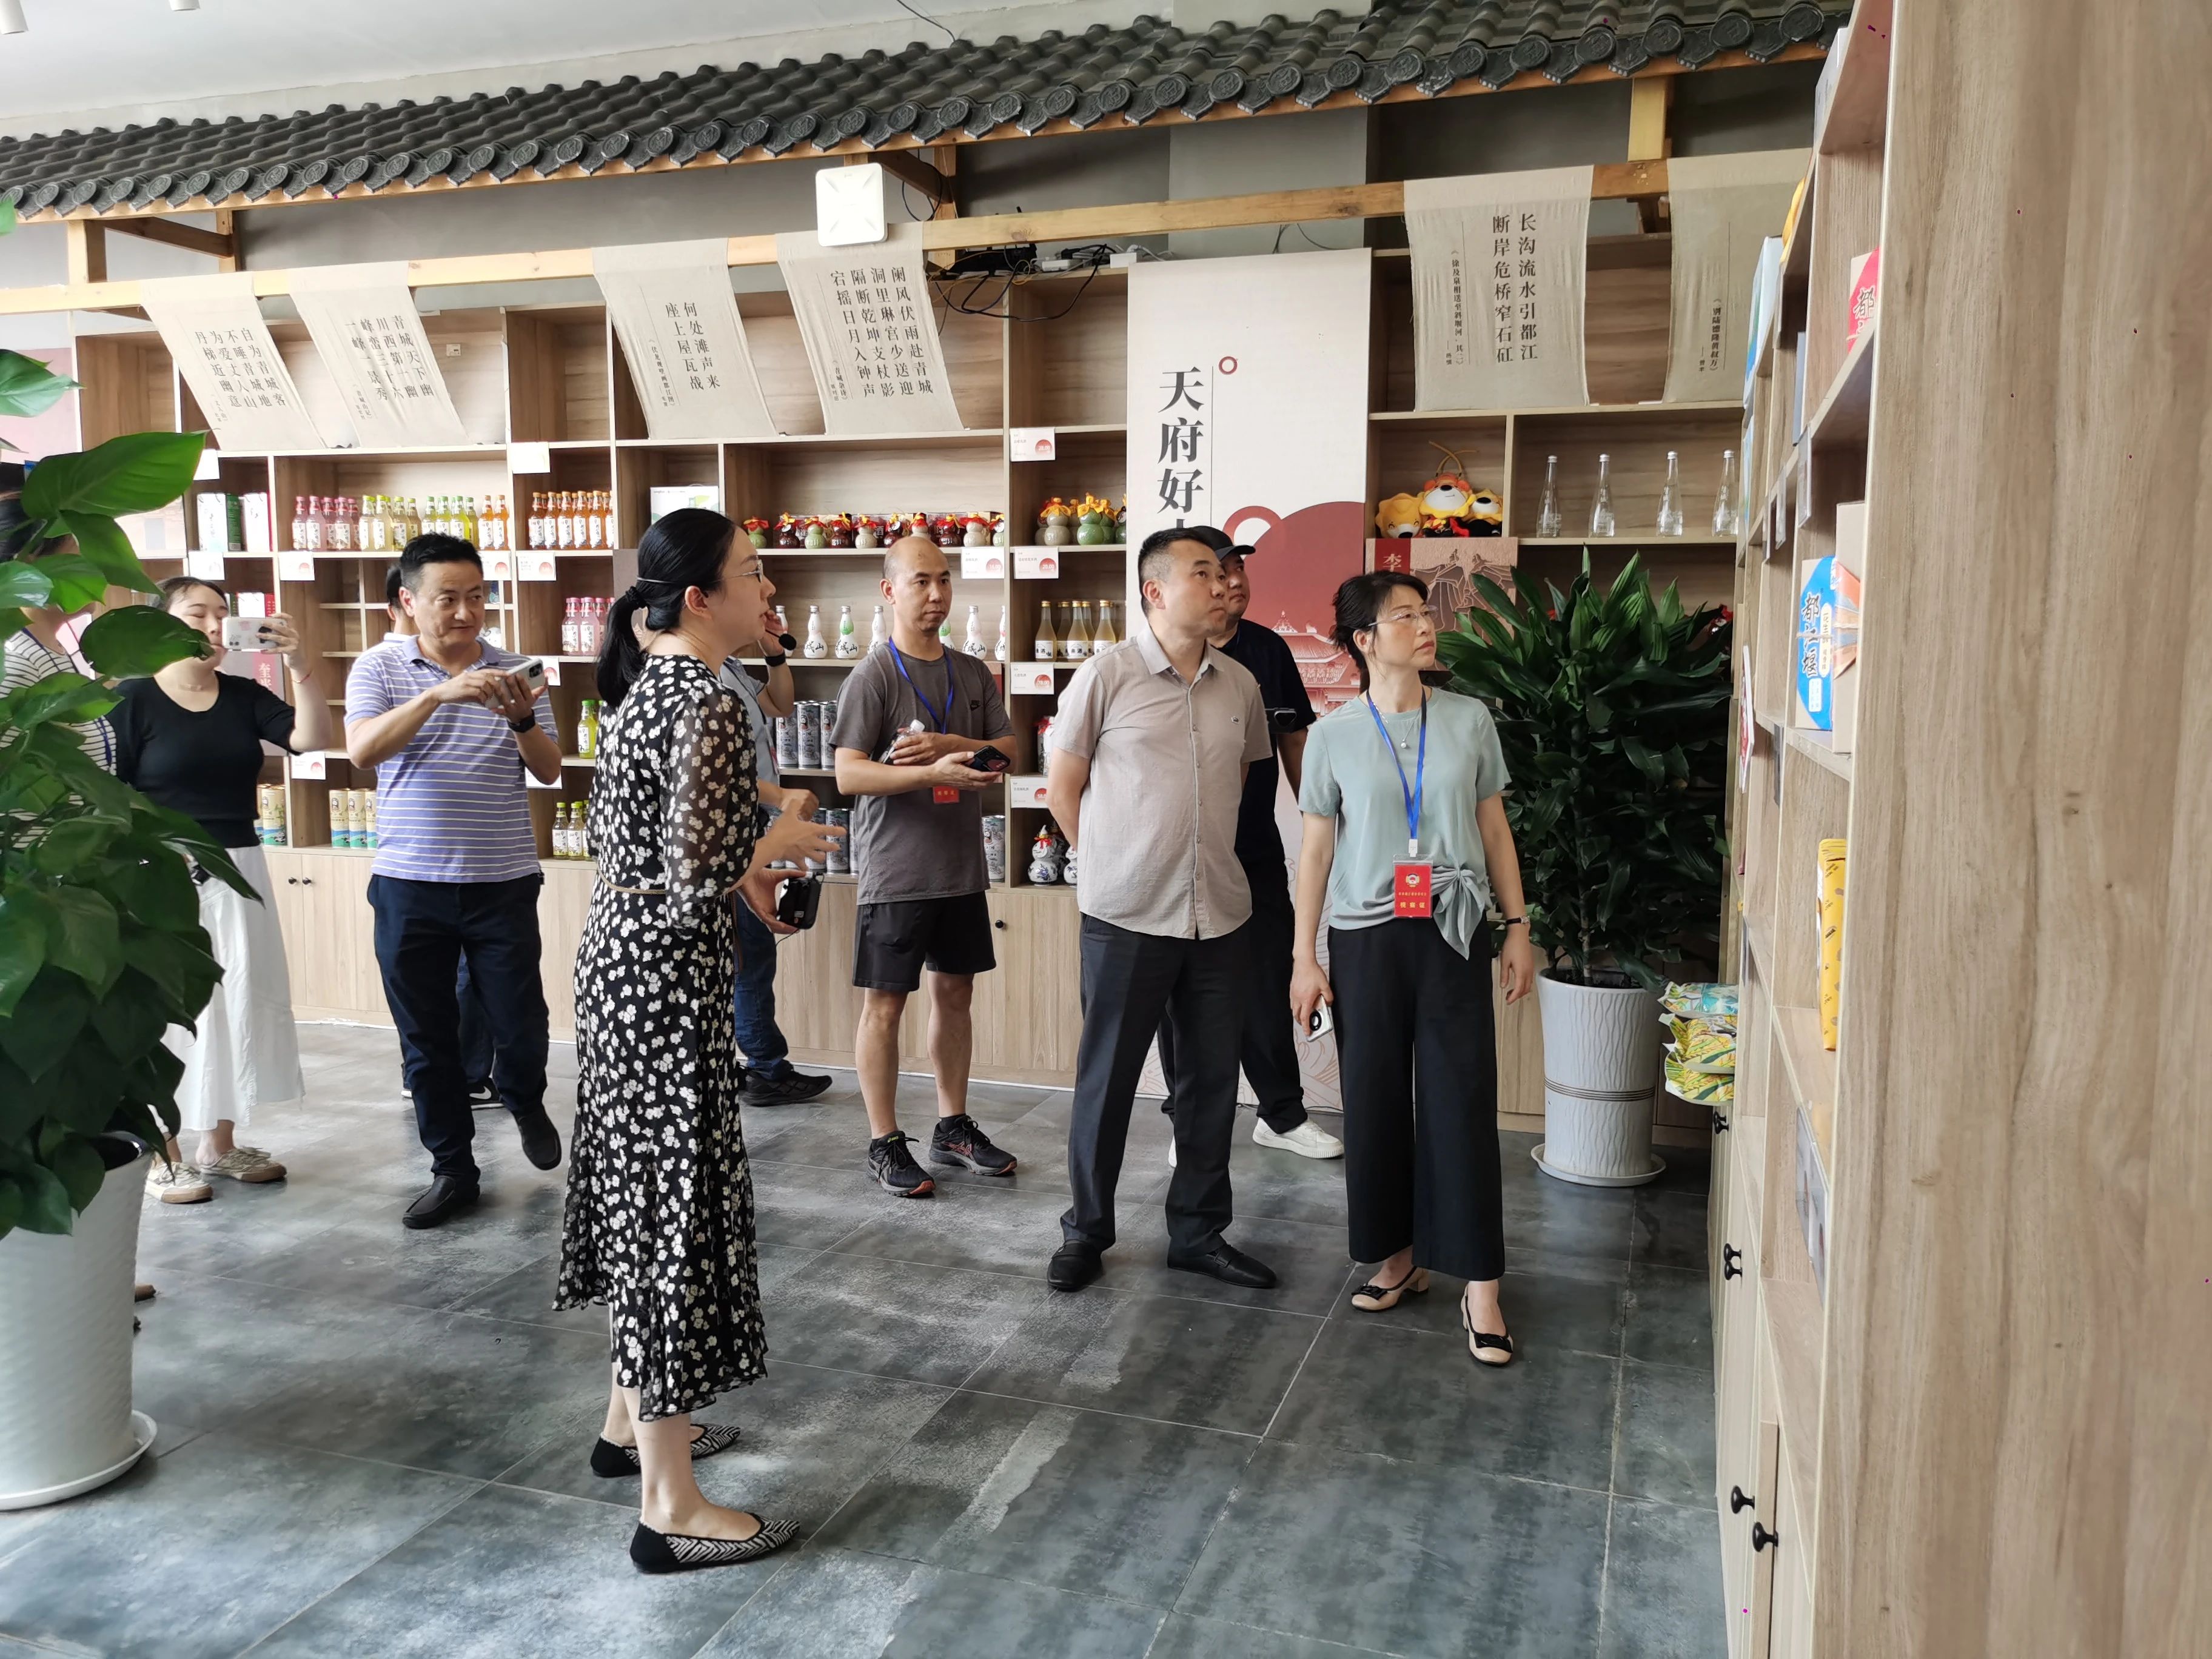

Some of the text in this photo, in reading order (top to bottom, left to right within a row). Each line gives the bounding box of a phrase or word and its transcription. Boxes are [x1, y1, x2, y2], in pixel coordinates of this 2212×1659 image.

[891, 266, 933, 394] 阆风伏雨赴青城
[1492, 215, 1513, 363] 断岸危桥窄石矼
[1518, 213, 1538, 361] 长沟流水引都江
[195, 332, 242, 407] 丹梯近幽意
[210, 330, 257, 408] 为爱丈人山
[241, 327, 287, 407] 自为青城客
[344, 322, 387, 400] 一峰一景秀
[360, 319, 404, 399] 峰峦三十六
[392, 315, 434, 396] 青城天下幽
[665, 303, 704, 390] 座上屋瓦战
[684, 302, 720, 389] 何处滩声来
[830, 270, 875, 398] 宕摇日月入钟声
[851, 268, 894, 398] 隔断乾坤支杖影
[871, 267, 914, 396] 洞里琳宫少送迎
[1158, 366, 1205, 529] 天府好
